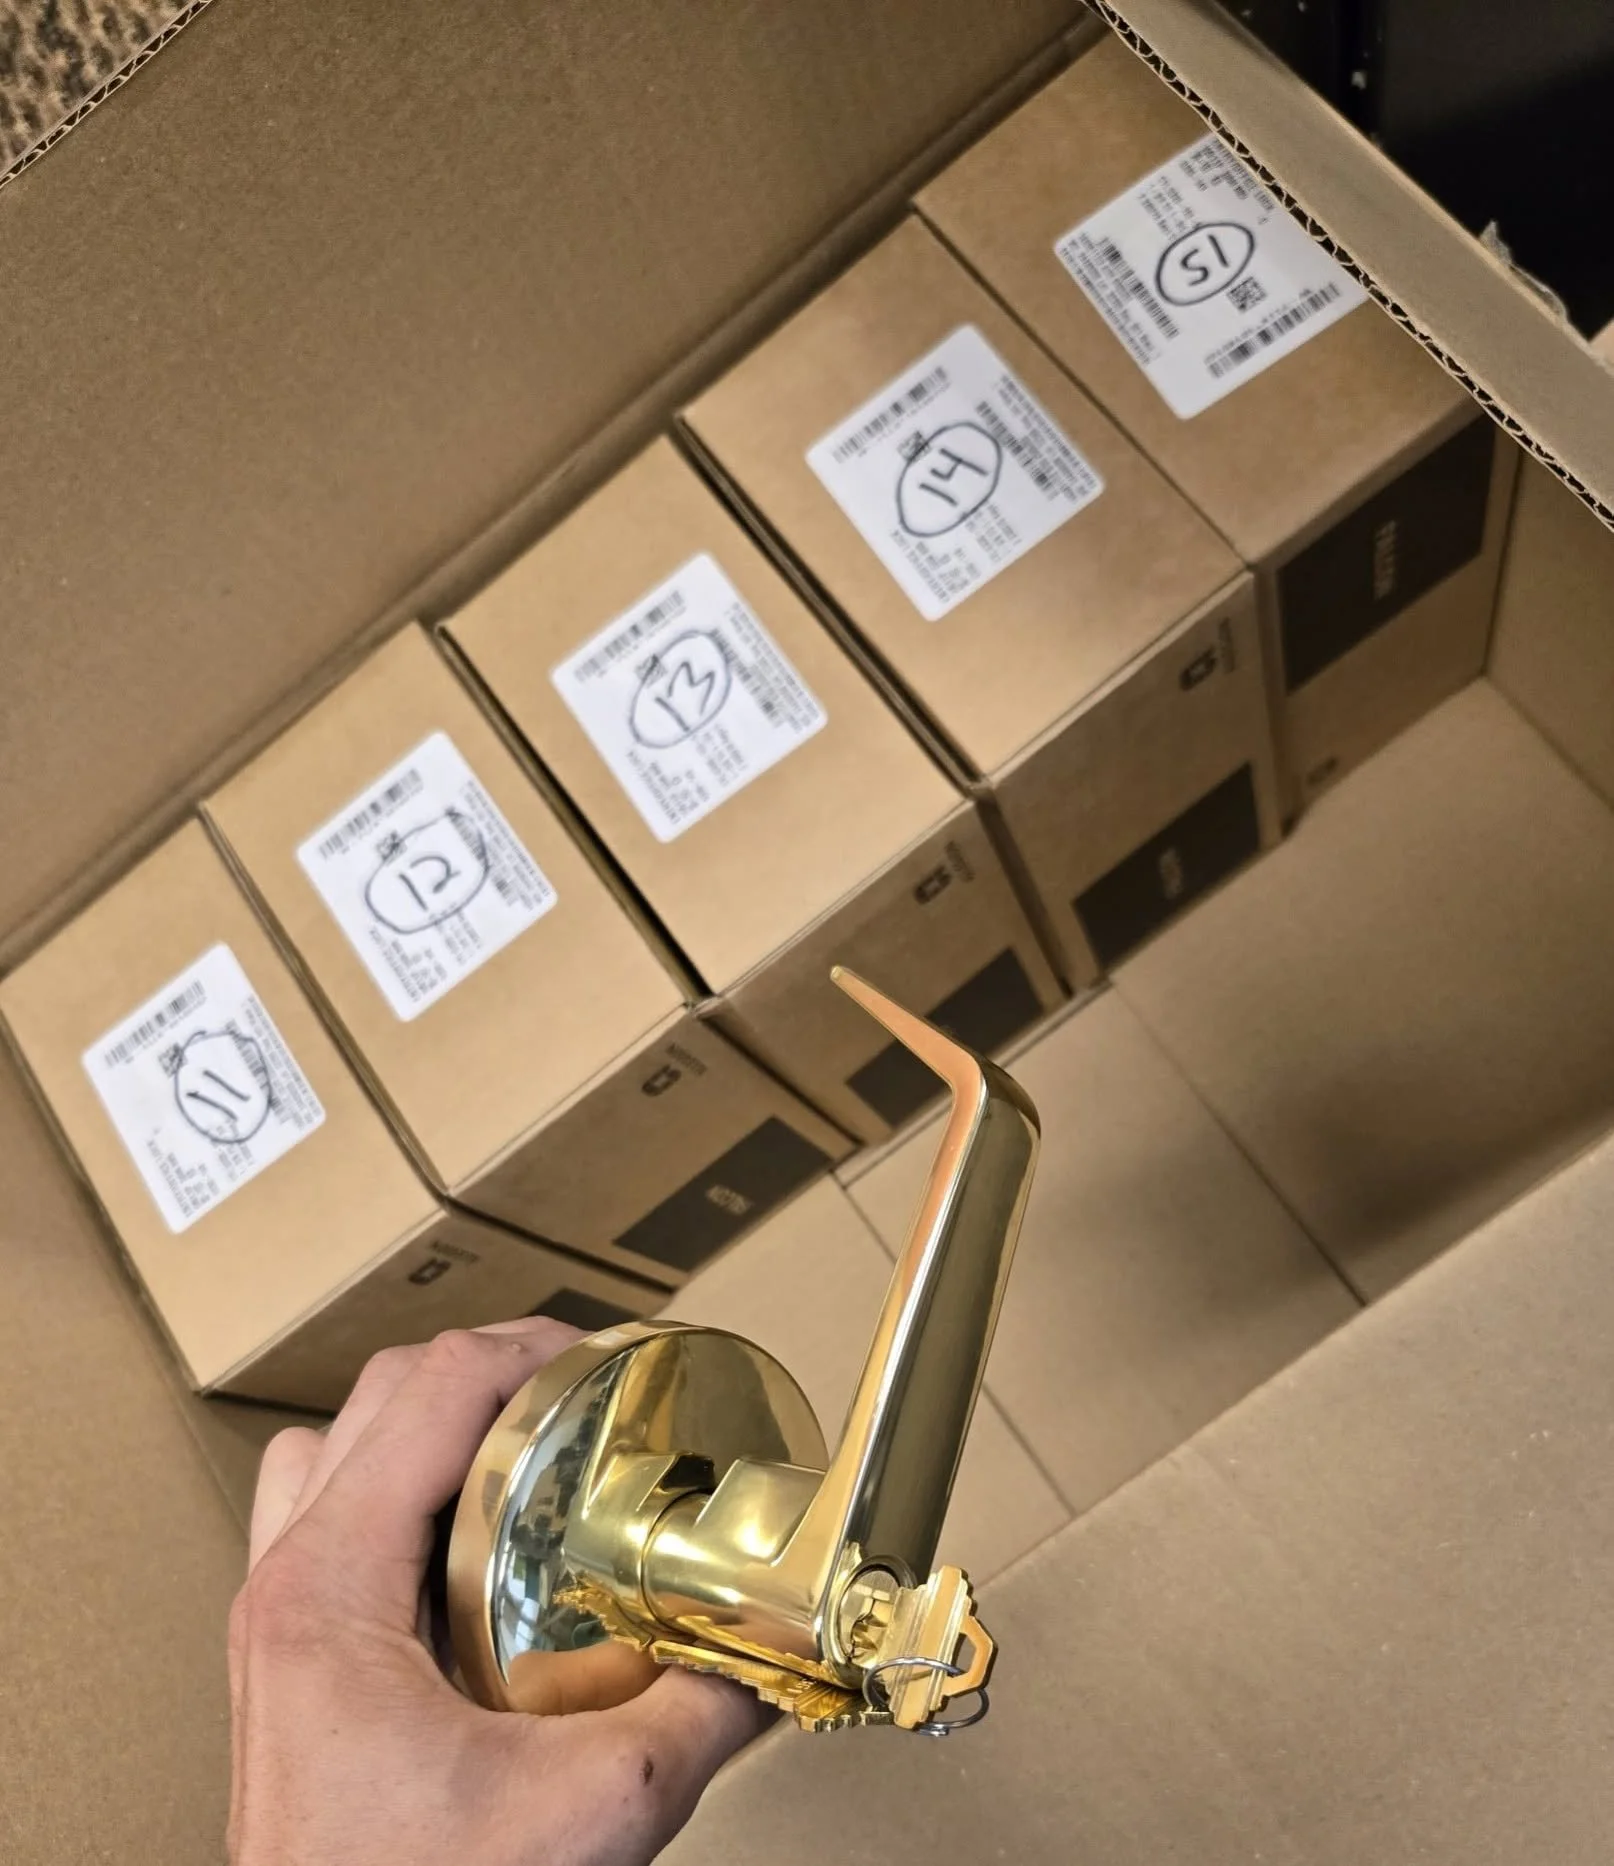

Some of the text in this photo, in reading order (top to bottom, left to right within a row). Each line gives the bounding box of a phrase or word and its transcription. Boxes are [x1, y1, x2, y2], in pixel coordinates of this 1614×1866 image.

[917, 447, 989, 508] 14
[653, 660, 716, 734] 13
[398, 855, 461, 912] 12
[185, 1068, 252, 1122] 11
